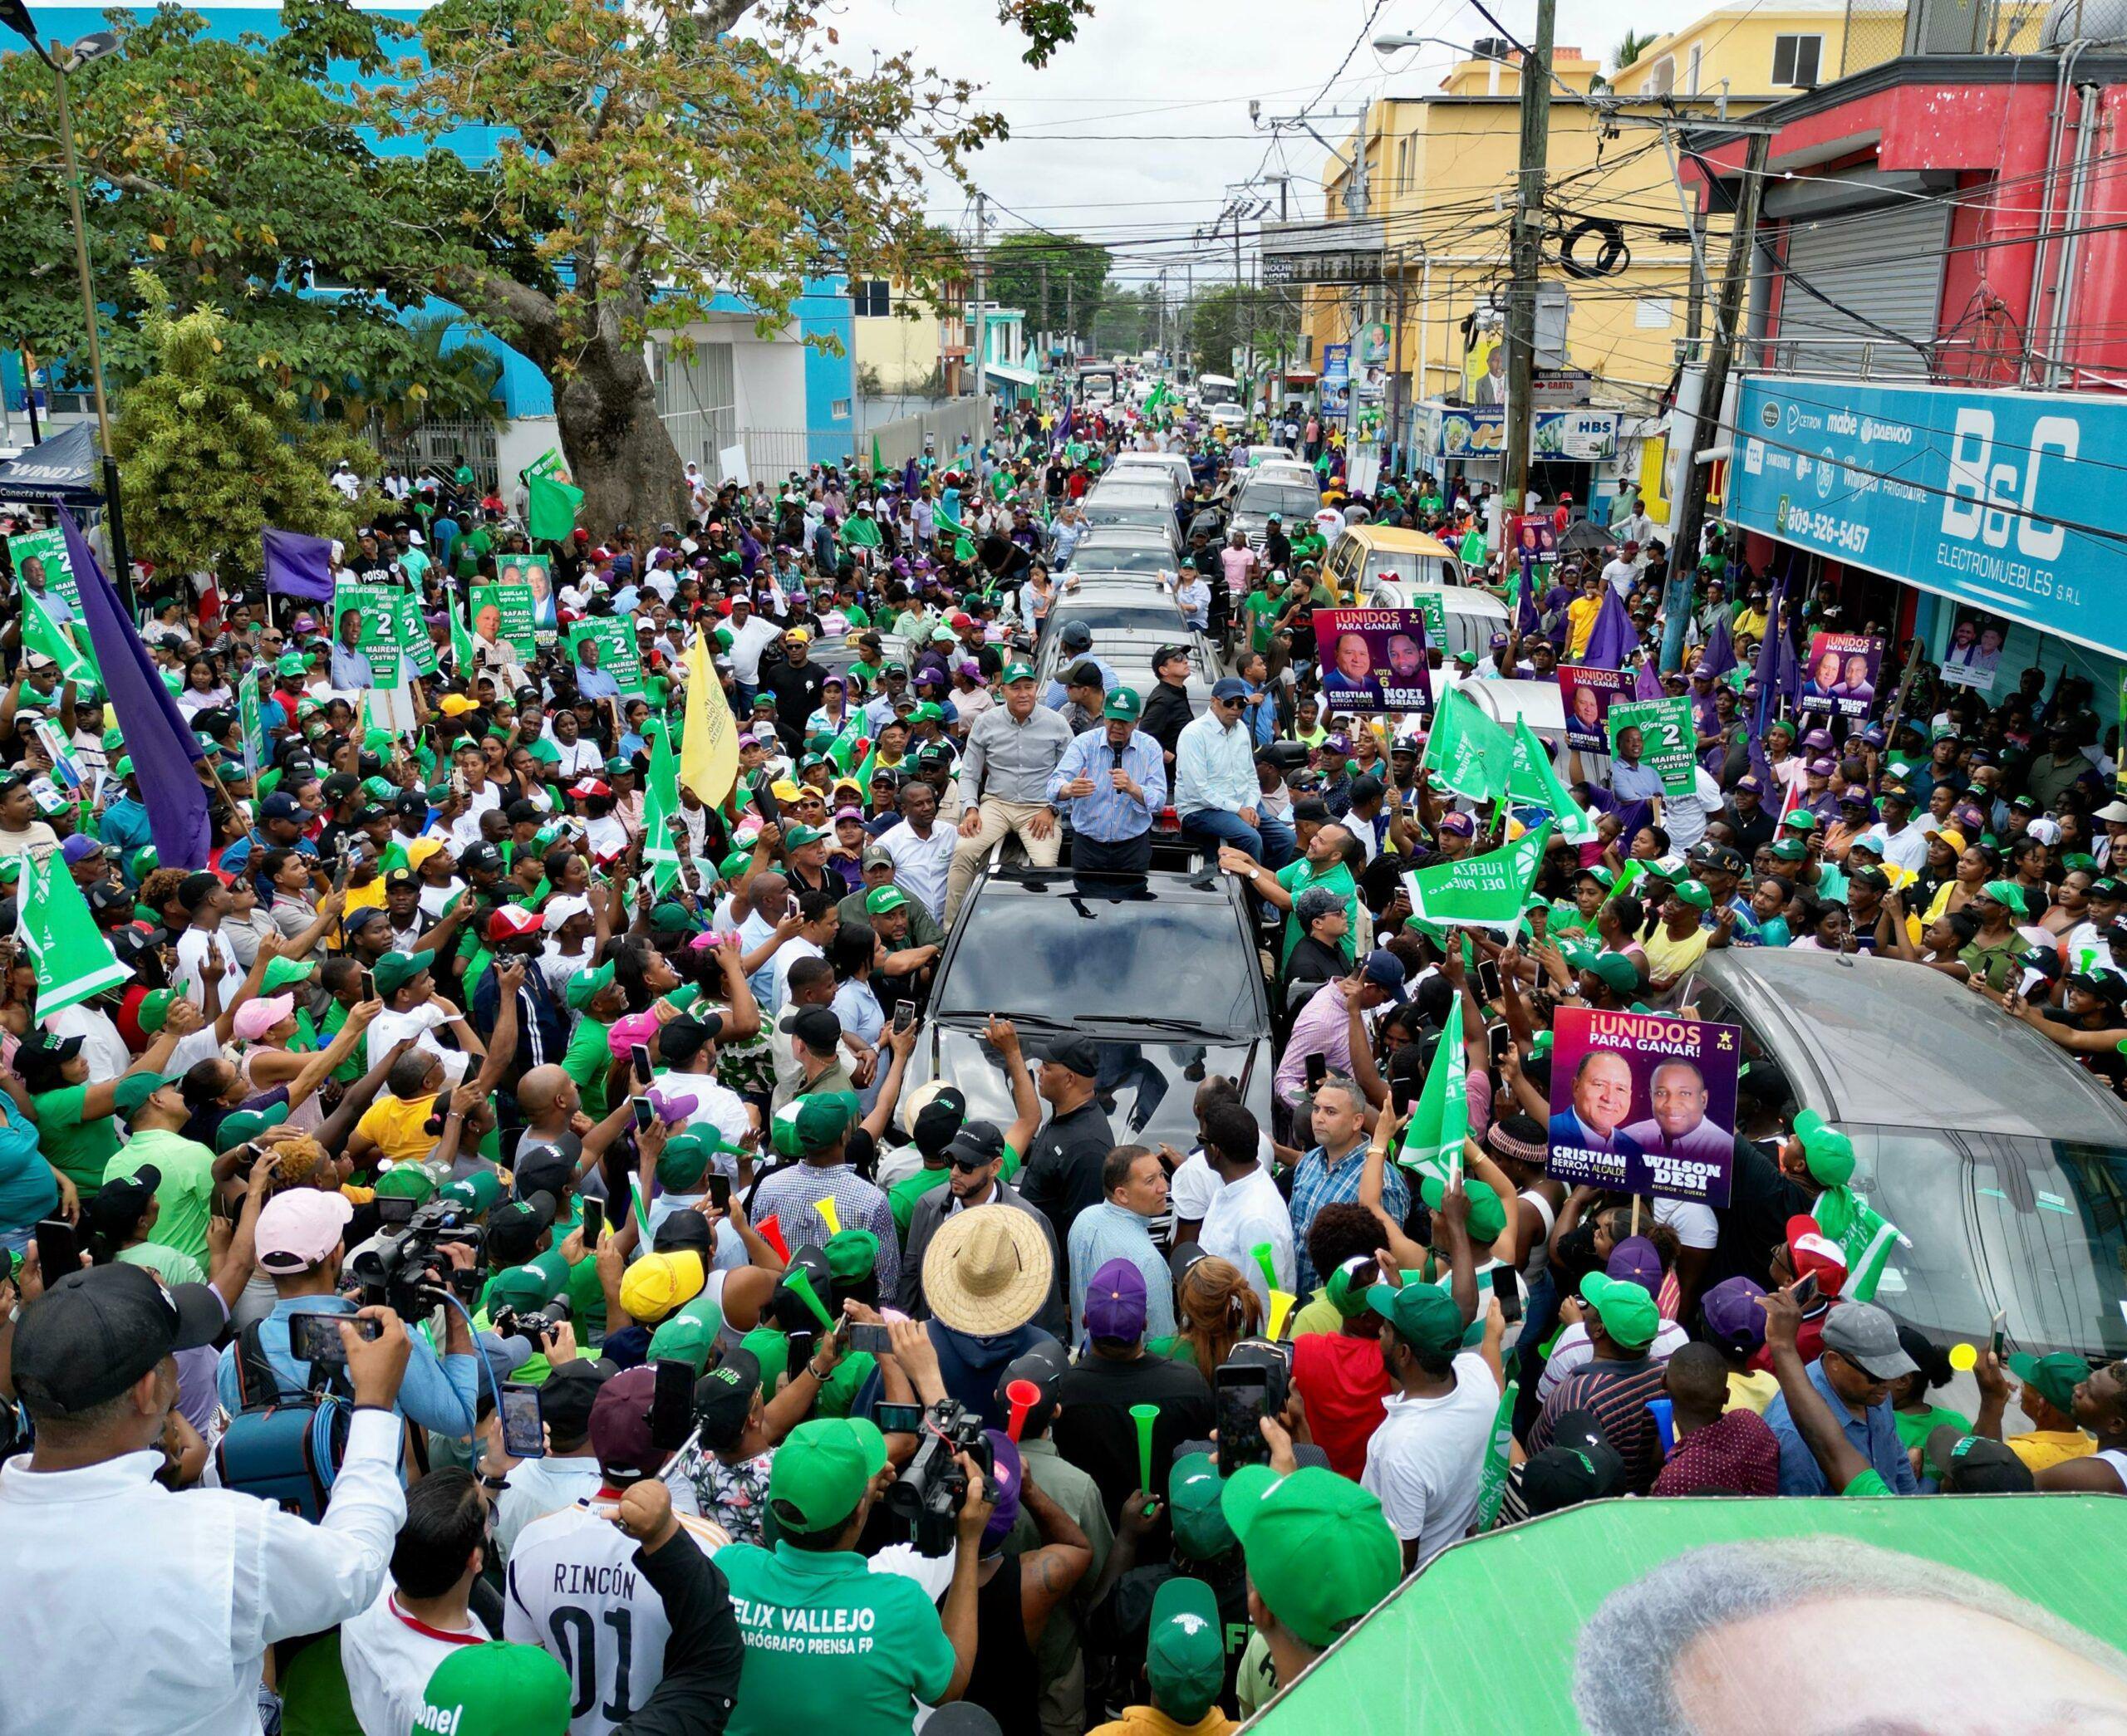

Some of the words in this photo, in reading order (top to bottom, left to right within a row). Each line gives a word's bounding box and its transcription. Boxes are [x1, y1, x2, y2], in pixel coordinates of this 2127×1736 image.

[1264, 264, 1294, 272] NOCHE
[1548, 382, 1574, 390] GRATIS
[1579, 421, 1611, 433] HBS
[1799, 415, 1822, 429] CETRON
[1827, 406, 1858, 436] mabe
[1873, 423, 1912, 445] DAEWOO
[1749, 448, 1761, 463] TCL
[1766, 453, 1791, 471] SAMSUNG
[7, 461, 71, 478] WIND
[0, 488, 33, 498] Conecta
[1883, 478, 1927, 503] FRIGIDAIRE
[1788, 506, 1869, 553] 809-526-5457
[58, 552, 72, 572] 2
[1937, 542, 2053, 596] ELECTROMUEBLES
[376, 613, 391, 635] 2
[1432, 609, 1440, 622] 2
[405, 618, 419, 636] 2
[612, 636, 626, 654] 2
[607, 660, 638, 669] MAIRENI
[1379, 676, 1389, 688] 6
[1383, 689, 1425, 699] NOEL
[1804, 696, 1832, 704] CRISTIAN
[1641, 701, 1671, 709] CASILLA
[1569, 732, 1599, 743] CRISTIAN
[1662, 724, 1680, 745] 2
[1651, 753, 1692, 764] MAIRENI
[1657, 762, 1689, 771] CASTRO
[1590, 1014, 1701, 1046] ¡UNIDOS
[1589, 1032, 1632, 1049] PARA
[1636, 1038, 1701, 1057] GANAR!
[1717, 1042, 1733, 1051] PLD
[1552, 1145, 1626, 1167] CRISTIAN
[1552, 1158, 1589, 1171] BERROA
[1592, 1162, 1626, 1176] ALCALDE
[1642, 1155, 1721, 1178] WILSON
[1653, 1169, 1707, 1190] DESI
[554, 1562, 636, 1601] RINCÓN
[782, 1607, 876, 1634] VALLEJO
[741, 1630, 805, 1654] ARÓGRAFO
[808, 1638, 855, 1655] PRENSA
[858, 1637, 874, 1654] FP
[549, 1606, 636, 1724] 01
